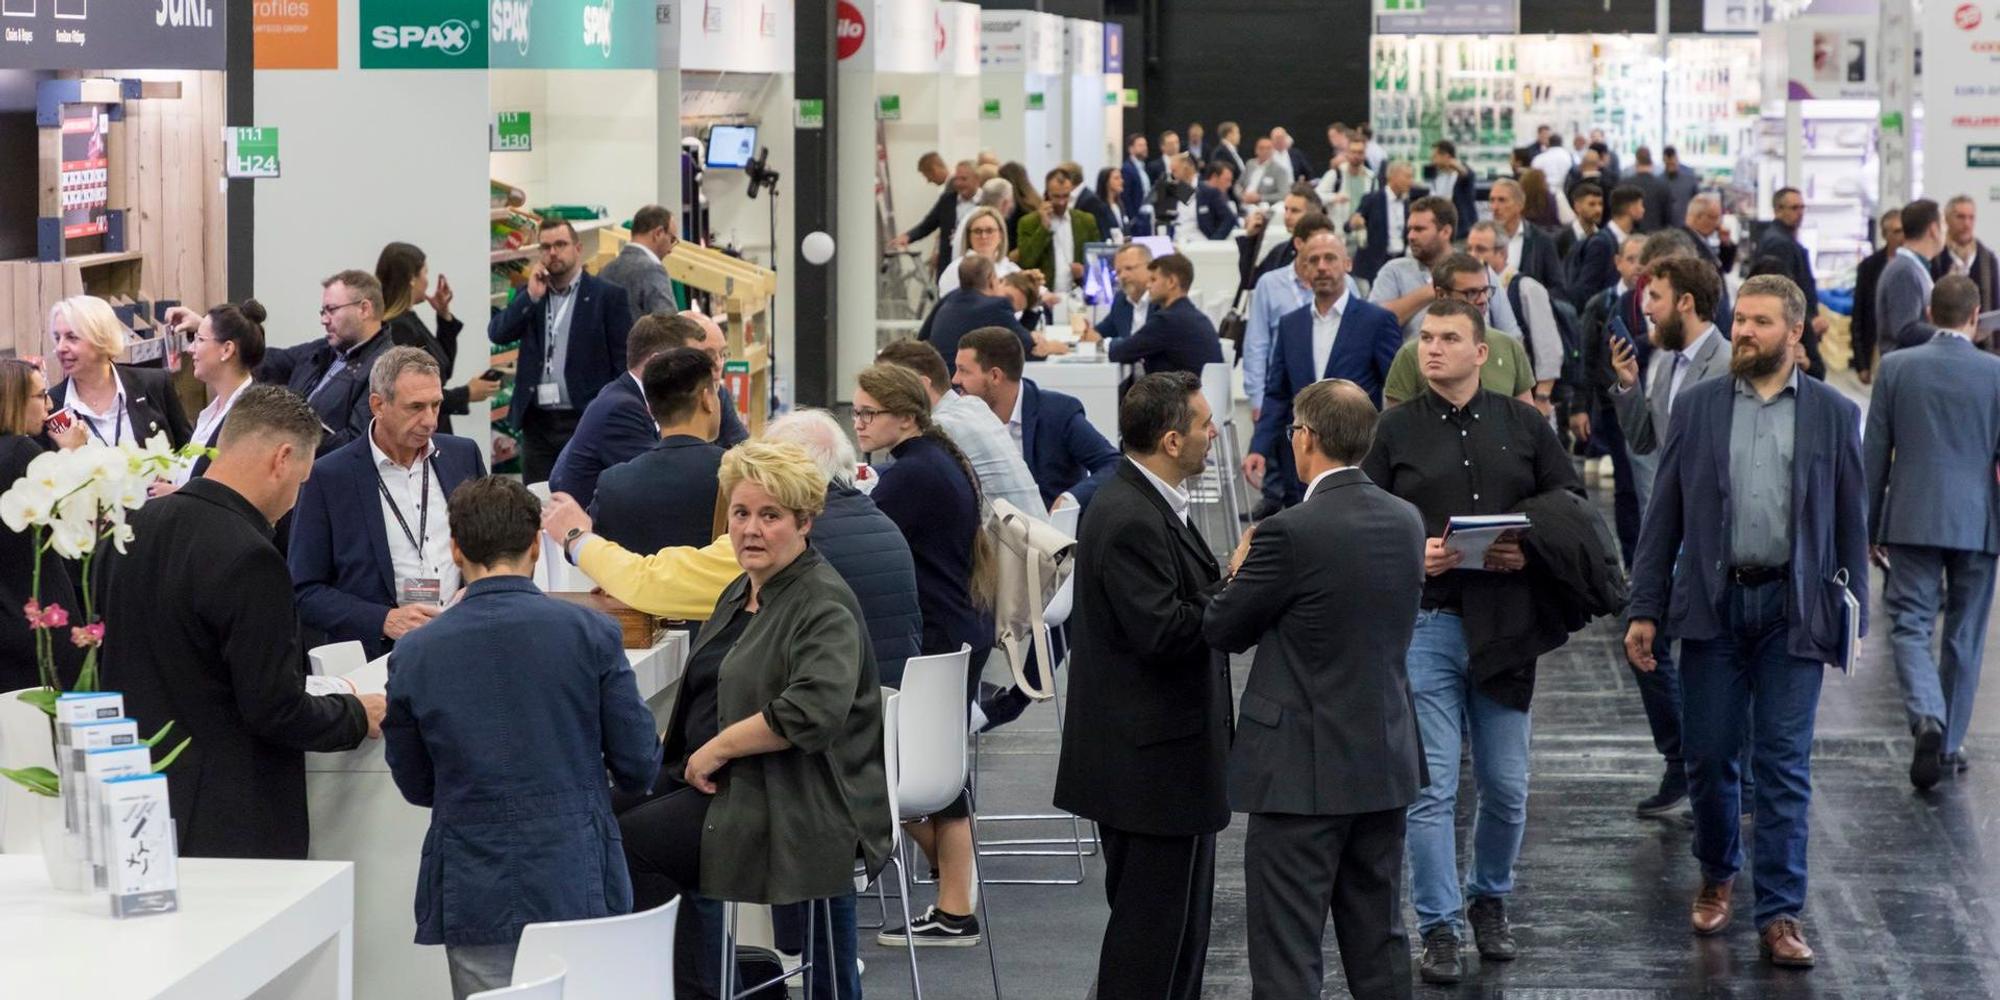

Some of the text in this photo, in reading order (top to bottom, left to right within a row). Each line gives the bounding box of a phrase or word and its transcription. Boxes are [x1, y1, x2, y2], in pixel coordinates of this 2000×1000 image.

[253, 0, 309, 17] rofiles
[491, 0, 528, 43] SPAX
[583, 4, 612, 46] SPAX
[837, 18, 864, 38] ilo
[371, 24, 468, 50] SPAX
[498, 111, 518, 123] 11.1
[239, 127, 262, 141] 11.1
[499, 133, 530, 149] H30
[238, 155, 278, 174] H24
